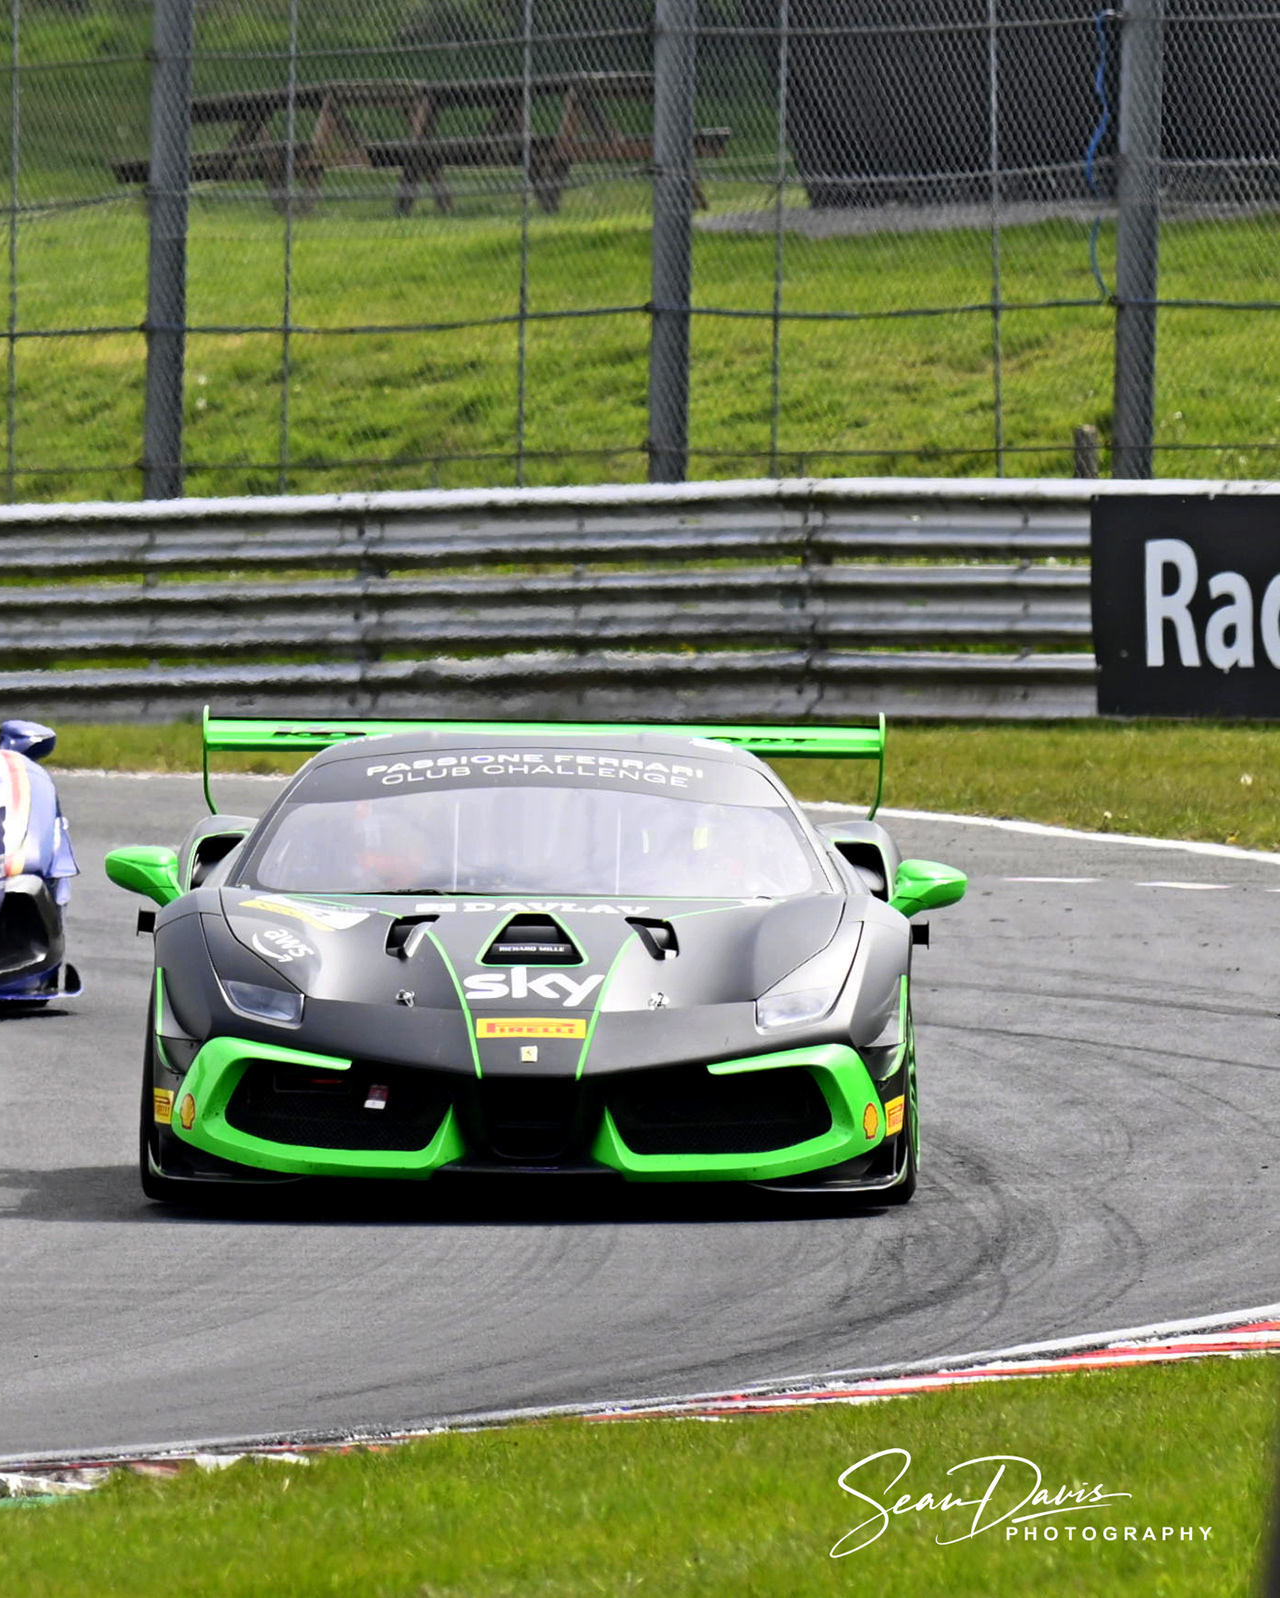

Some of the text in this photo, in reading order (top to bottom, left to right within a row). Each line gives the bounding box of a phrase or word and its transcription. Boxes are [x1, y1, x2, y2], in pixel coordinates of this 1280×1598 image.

[366, 753, 704, 779] PASSIONE FERRARI
[381, 764, 689, 788] CLUB CHALLENGE
[263, 928, 316, 958] aws
[463, 967, 606, 1007] sky
[486, 1022, 576, 1034] PIRELLI
